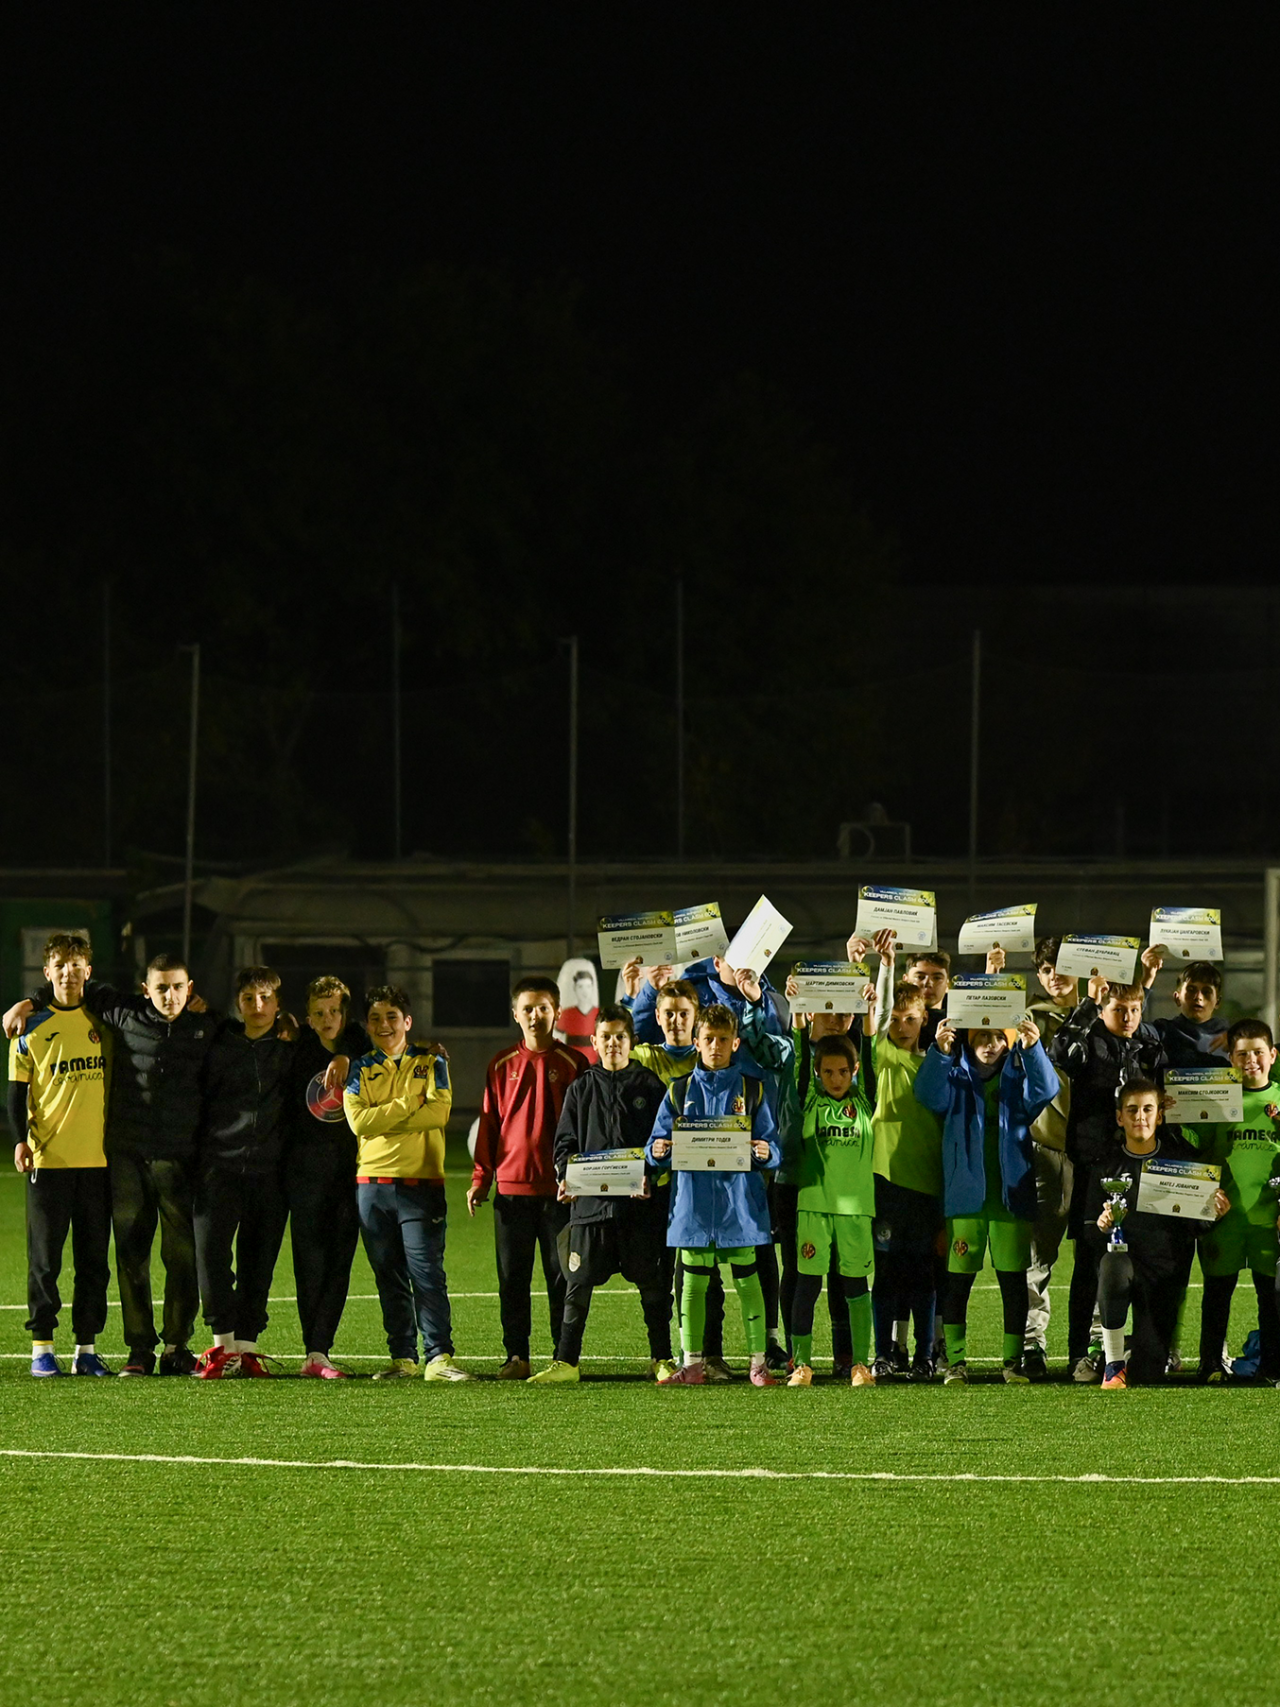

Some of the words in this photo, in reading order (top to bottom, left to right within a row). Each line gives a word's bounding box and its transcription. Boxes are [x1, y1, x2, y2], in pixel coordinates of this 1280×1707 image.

[863, 891, 892, 899] KEEPERS
[683, 913, 705, 923] CLASH
[682, 926, 709, 936] НИКОЛОВСКИ
[611, 935, 629, 943] ВЕДРАН
[630, 933, 663, 941] СТОЈАНОВСКИ
[50, 1056, 106, 1076] PAMESA
[1147, 1164, 1177, 1173] KEEPERS
[1178, 1168, 1201, 1176] CLASH
